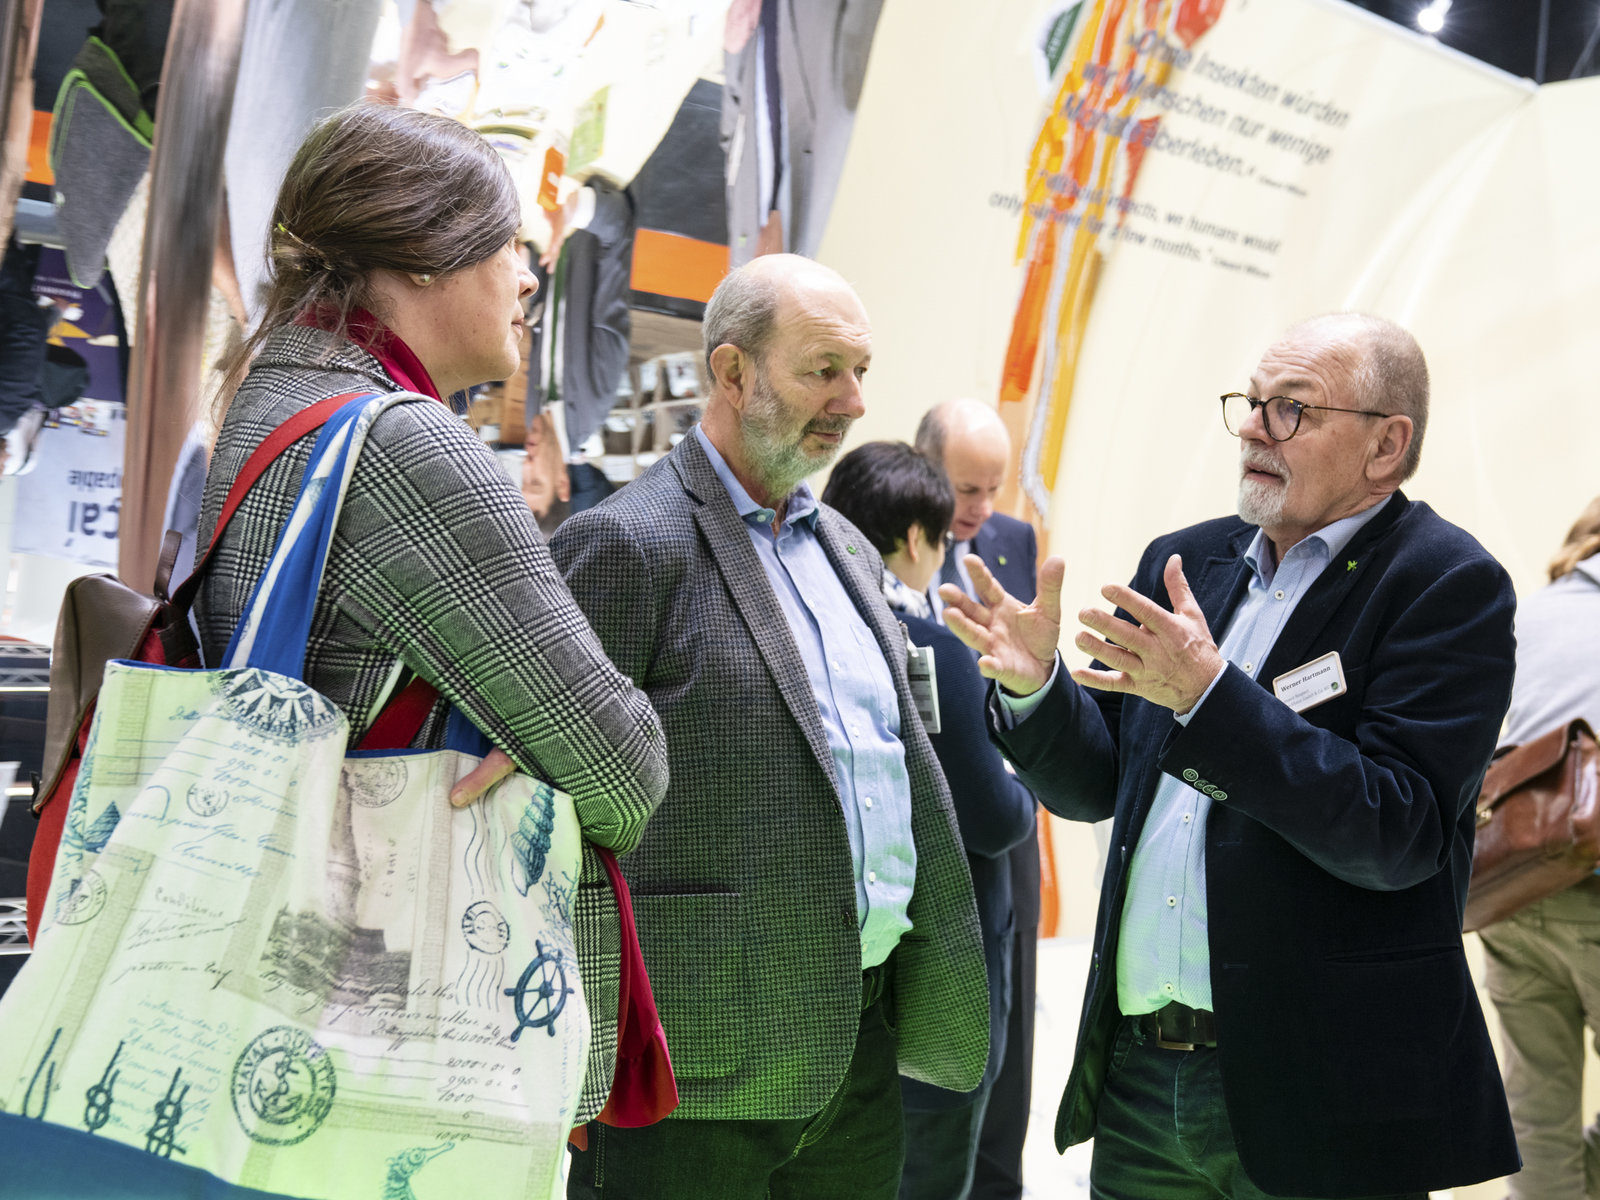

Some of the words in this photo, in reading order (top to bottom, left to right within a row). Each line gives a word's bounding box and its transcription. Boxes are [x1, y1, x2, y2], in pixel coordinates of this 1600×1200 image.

[1193, 51, 1280, 100] Insekten
[1281, 90, 1350, 128] würden
[1227, 110, 1266, 141] nur
[1265, 124, 1334, 167] wenige
[987, 189, 1027, 219] only
[1163, 209, 1185, 228] we
[1281, 679, 1302, 693] Werner
[1302, 666, 1332, 683] Hartmann
[237, 1038, 269, 1096] NAVAL
